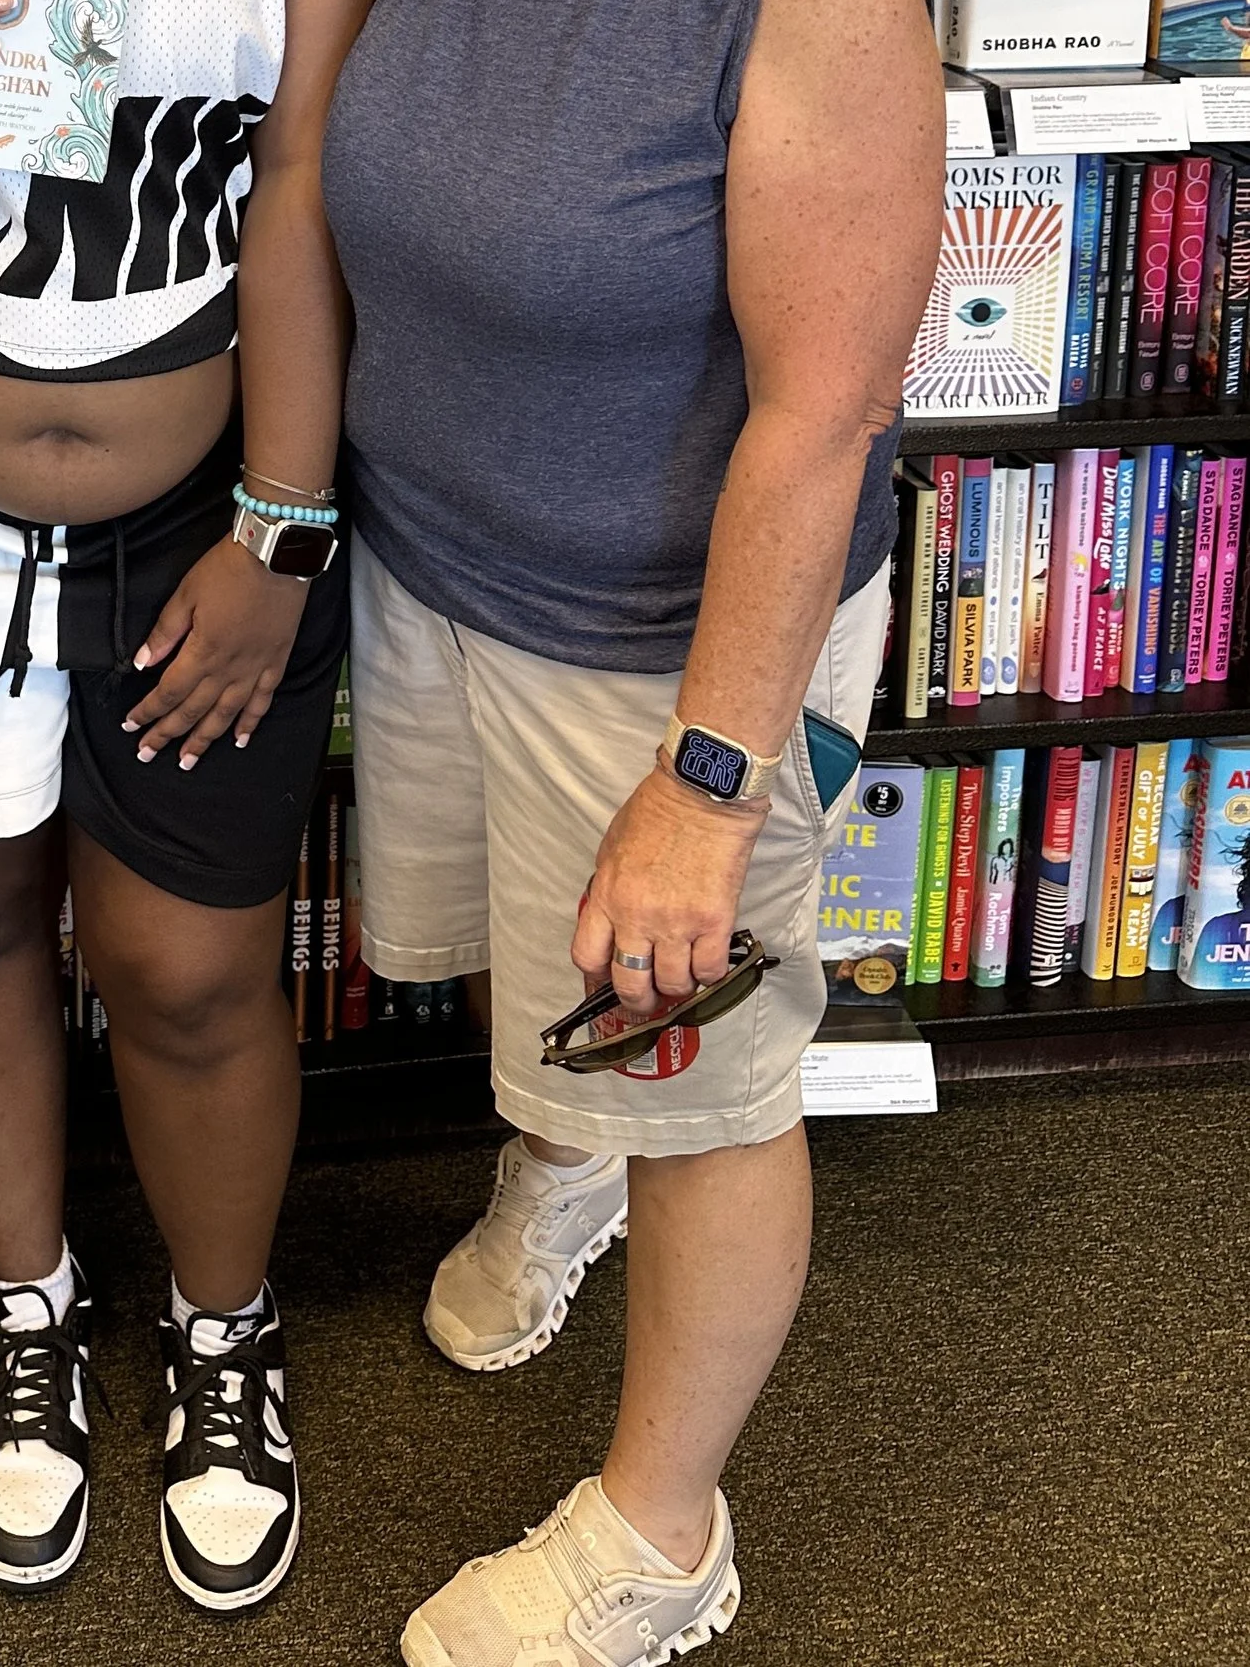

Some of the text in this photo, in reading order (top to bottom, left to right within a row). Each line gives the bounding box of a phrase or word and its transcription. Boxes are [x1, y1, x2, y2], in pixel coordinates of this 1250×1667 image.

[982, 36, 1101, 51] SHOBHA RAO
[1031, 93, 1087, 104] Indian Country
[1012, 166, 1063, 185] FOR
[1140, 169, 1177, 325] SOFT CORE
[903, 392, 1048, 410] STUART NADLER
[968, 482, 983, 558] LUMINOUS
[1035, 483, 1052, 560] TILT
[933, 470, 955, 676] GHOST WEDDING DAVID PARK
[1188, 470, 1216, 675] STAG DANCE TORREY PETERS
[961, 604, 977, 686] SILVIA PARK
[1131, 770, 1153, 860] GIFT OF JULY
[322, 897, 340, 971] BEINGS
[924, 891, 944, 964] DAVID RABE
